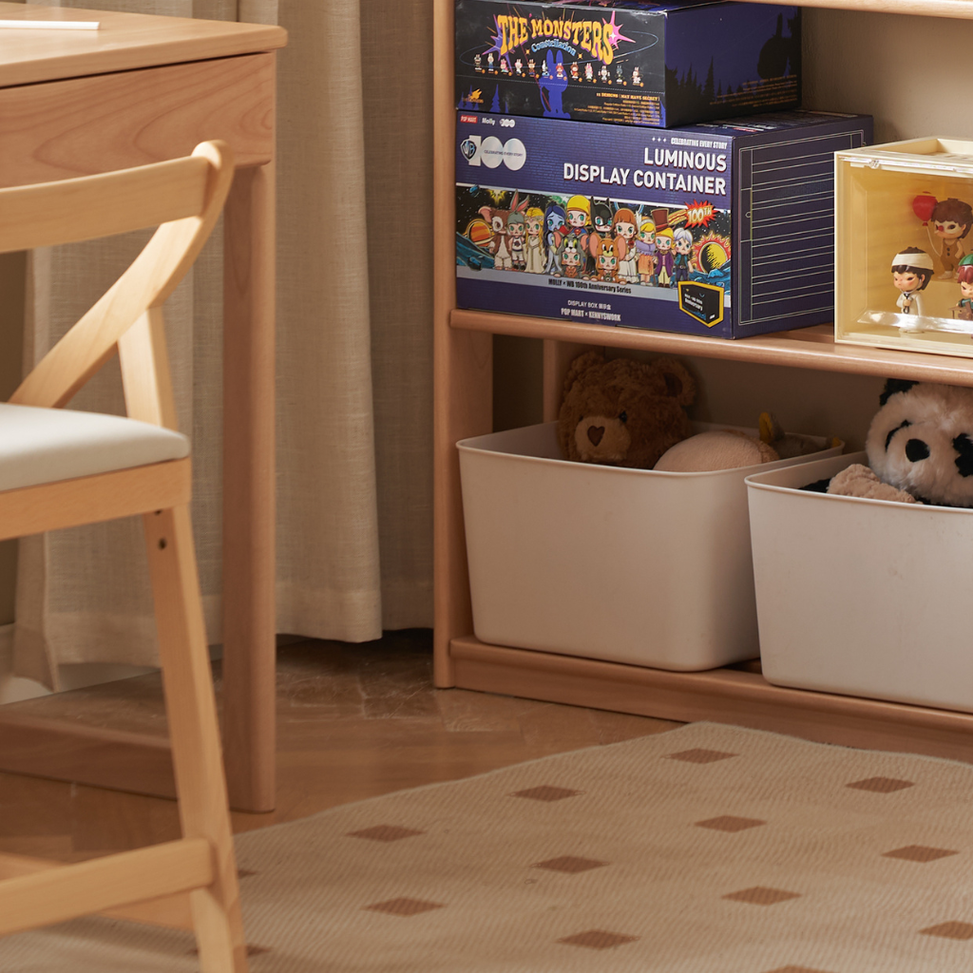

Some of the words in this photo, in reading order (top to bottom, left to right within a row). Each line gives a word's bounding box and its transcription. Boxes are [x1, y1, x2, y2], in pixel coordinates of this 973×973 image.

[497, 15, 529, 56] THE
[530, 18, 614, 65] MONSTERS
[644, 147, 727, 172] LUMINOUS
[563, 162, 630, 185] DISPLAY
[633, 169, 726, 196] CONTAINER
[687, 208, 712, 222] 100TH
[567, 299, 587, 307] DISPLAY
